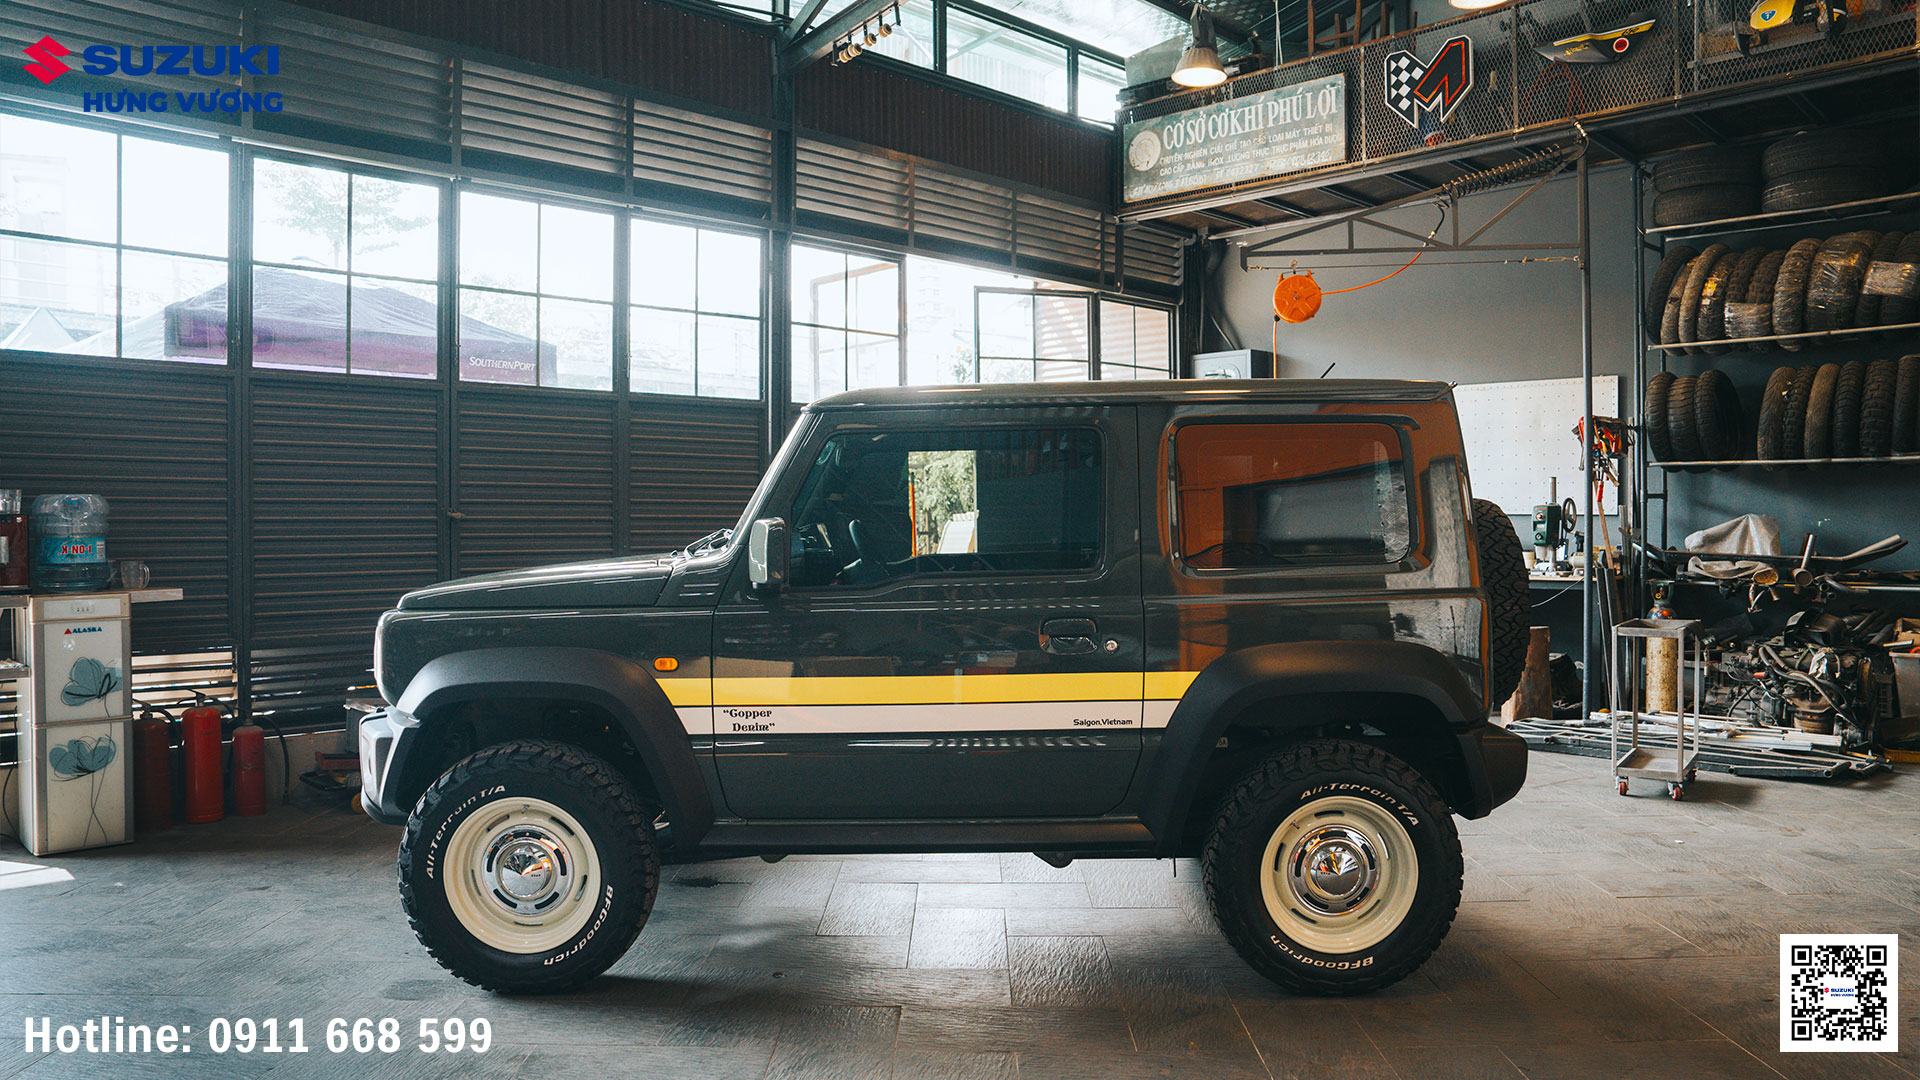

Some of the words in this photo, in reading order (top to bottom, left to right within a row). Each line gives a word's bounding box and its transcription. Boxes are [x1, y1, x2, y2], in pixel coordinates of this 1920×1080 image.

[1163, 120, 1185, 149] CƠ
[1186, 112, 1206, 145] SỞ
[1207, 109, 1229, 140] CƠ
[1229, 99, 1264, 135] KHÍ
[1266, 89, 1303, 127] PHÚ
[1305, 84, 1337, 120] LỢI
[426, 795, 477, 879] All-Terrain
[480, 785, 506, 798] T/A
[1300, 782, 1396, 805] All-Terrain
[1398, 803, 1420, 826] T/A
[544, 884, 614, 966] BFGoodrich
[1269, 934, 1374, 971] BFGoodrich
